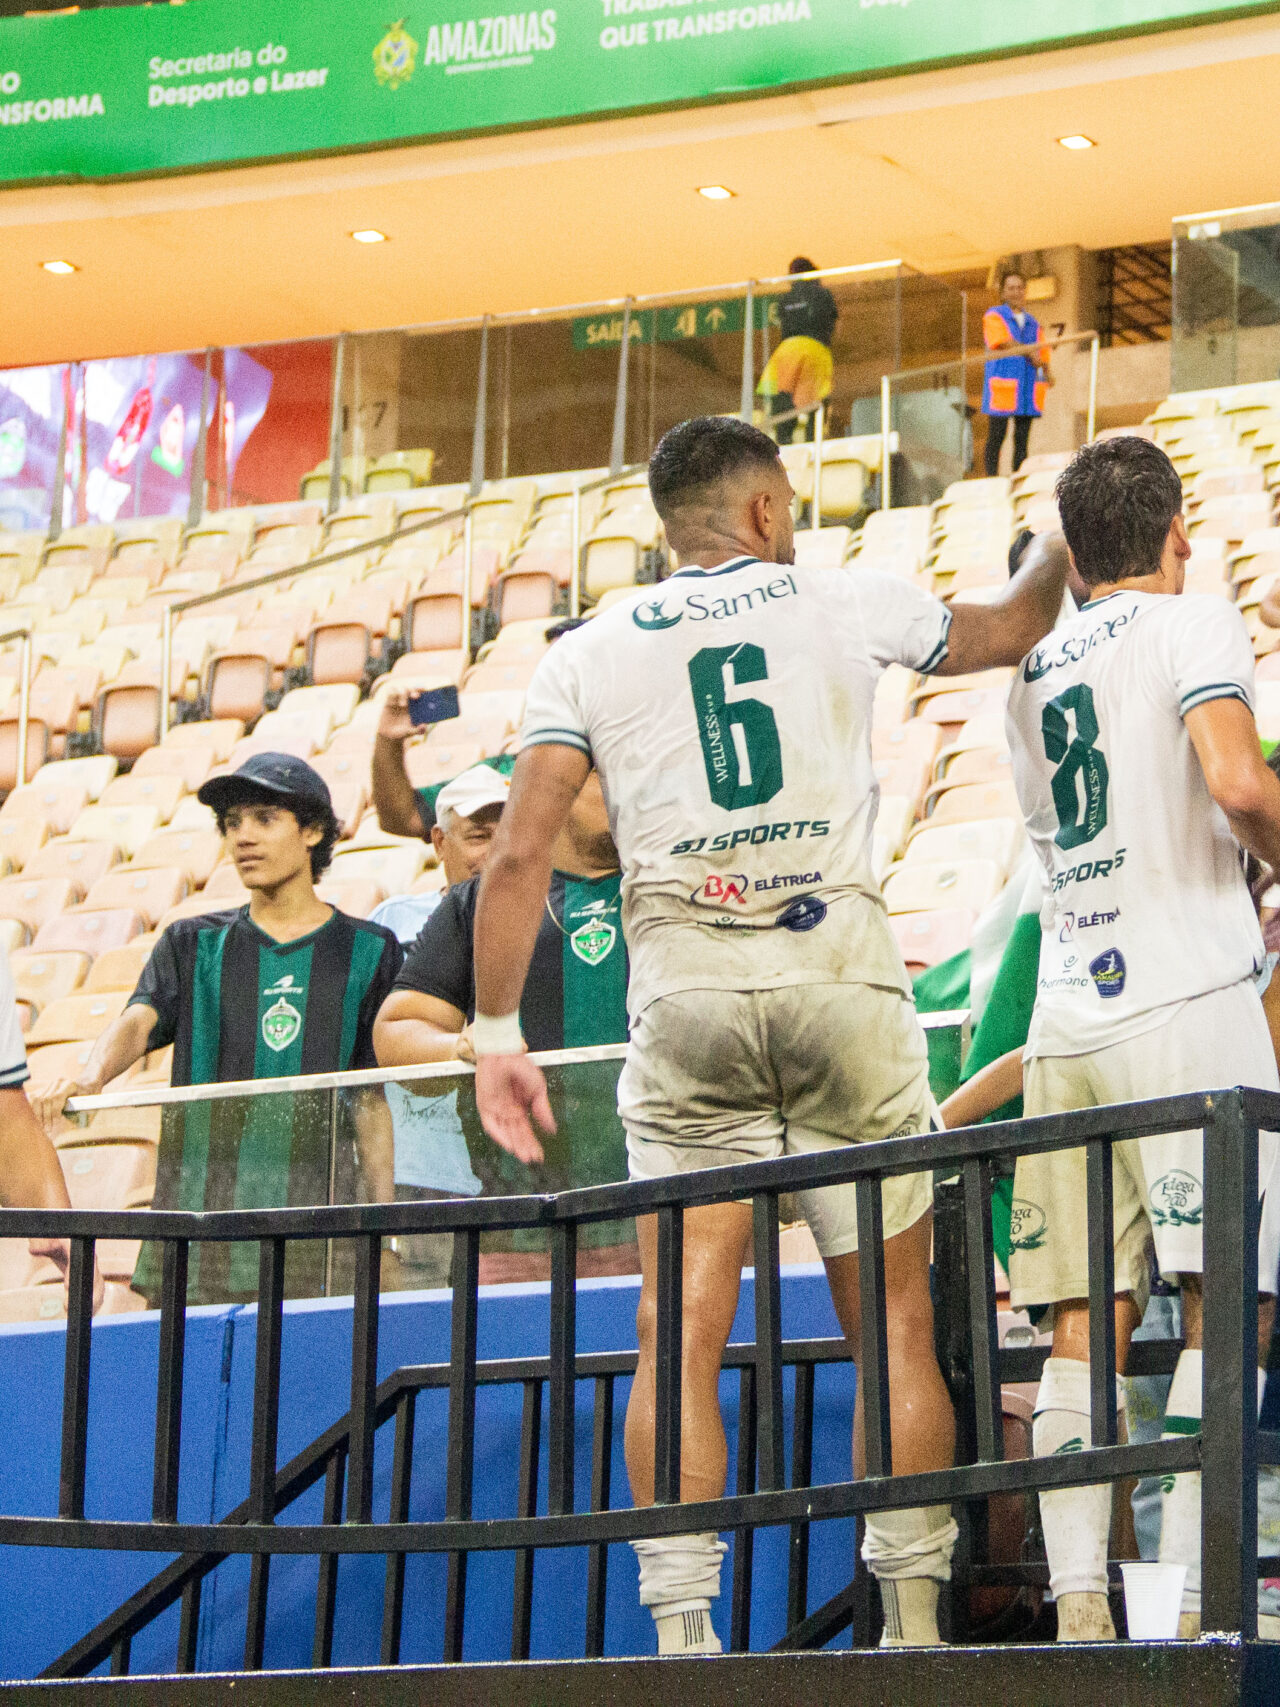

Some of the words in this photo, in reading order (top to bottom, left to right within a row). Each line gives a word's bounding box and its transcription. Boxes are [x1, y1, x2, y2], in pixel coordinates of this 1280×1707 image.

[424, 9, 557, 66] AMAZONAS
[599, 20, 649, 50] QUE
[652, 1, 812, 42] TRANSFORMA
[148, 47, 251, 80] Secretaria
[256, 42, 287, 66] do
[148, 77, 250, 108] Desporto
[252, 76, 268, 95] e
[270, 67, 329, 92] Lazer
[686, 573, 798, 621] Samel
[688, 641, 784, 812] 6
[705, 713, 729, 784] WELLNESS
[1041, 682, 1109, 851] 8
[1086, 768, 1100, 837] WELLNESS
[670, 837, 707, 856] SJ
[708, 820, 831, 852] SPORTS
[755, 871, 823, 892] ELÉTRICA
